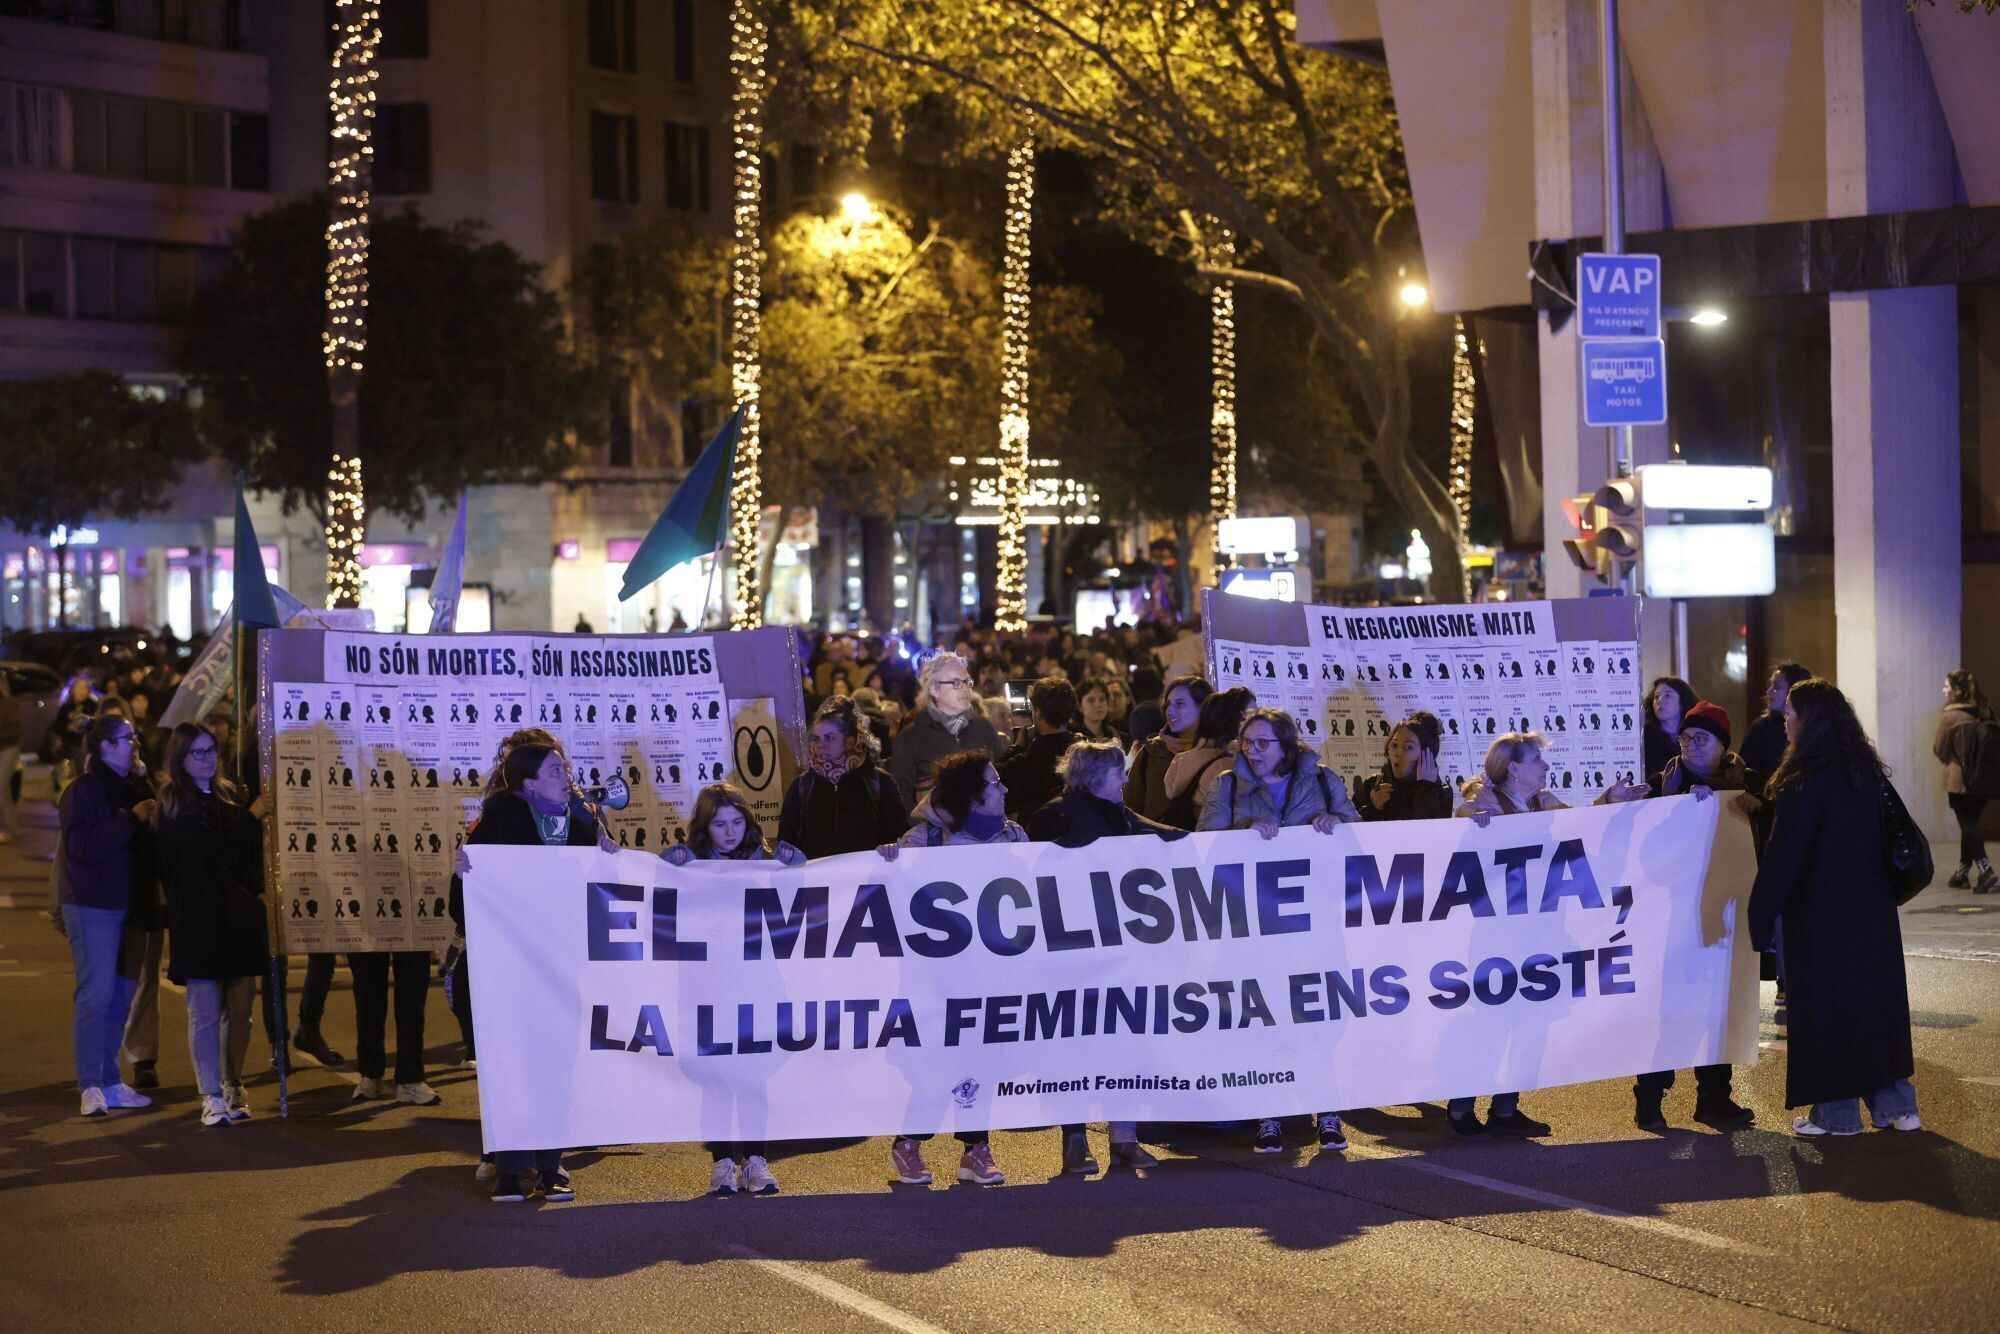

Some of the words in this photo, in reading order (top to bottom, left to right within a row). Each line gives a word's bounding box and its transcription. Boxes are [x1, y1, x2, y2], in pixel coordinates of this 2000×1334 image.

[1586, 266, 1654, 294] VAP
[1588, 307, 1602, 315] VIA
[1595, 319, 1644, 328] PREFERENT
[1606, 397, 1642, 407] MOTOS
[1614, 386, 1636, 395] TAXI
[1321, 615, 1344, 639] EL
[1344, 613, 1478, 641] NEGACIONISME
[1482, 611, 1536, 636] MATA
[345, 644, 372, 674] NO
[379, 640, 420, 676] SÓN
[428, 647, 525, 680] MORTES,
[532, 642, 565, 678] SÓN
[570, 647, 713, 679] ASSASSINADES
[587, 881, 708, 962] EL
[744, 858, 1312, 961] MASCLISME
[1345, 838, 1634, 929] MATA,
[590, 1004, 675, 1057] LA
[697, 998, 922, 1057] LLUITA
[944, 978, 1277, 1048] FEMINISTA
[1288, 964, 1411, 1025] ENS
[1428, 930, 1636, 1010] SOSTÉ
[997, 1076, 1090, 1097] Moviment
[1095, 1075, 1191, 1091] Feminista
[1195, 1074, 1218, 1090] de
[1221, 1068, 1296, 1089] Mallorca
